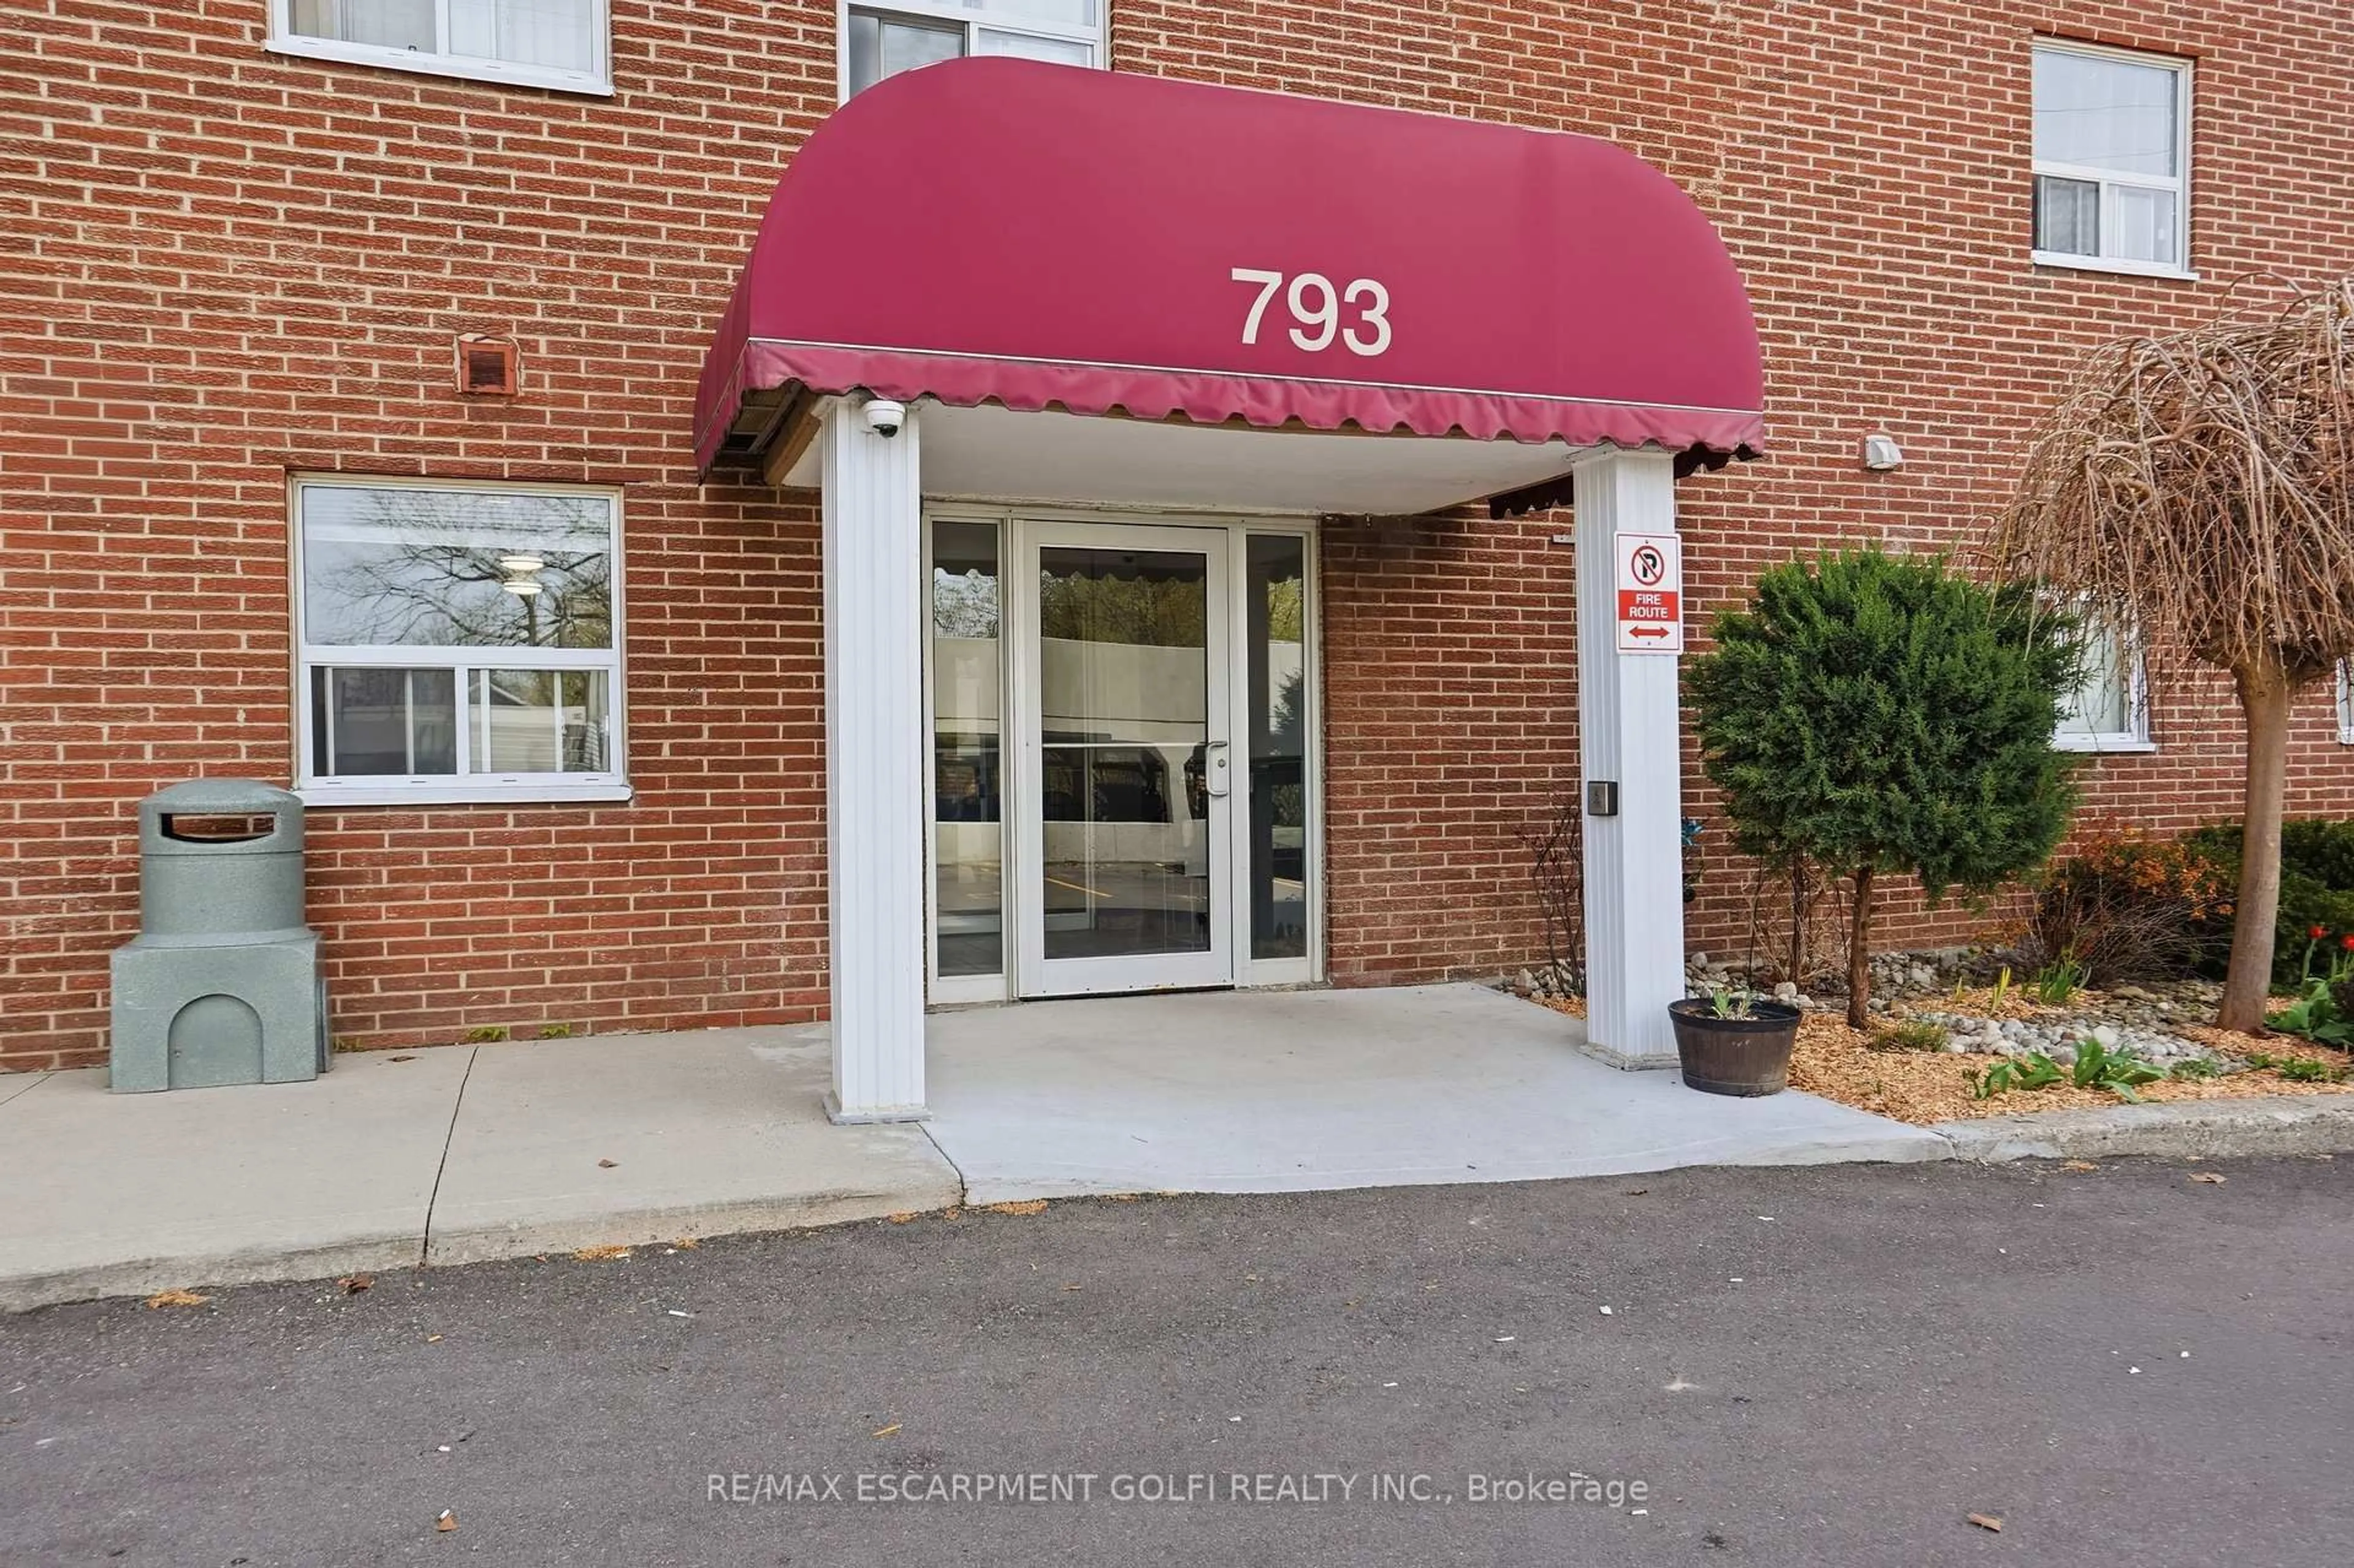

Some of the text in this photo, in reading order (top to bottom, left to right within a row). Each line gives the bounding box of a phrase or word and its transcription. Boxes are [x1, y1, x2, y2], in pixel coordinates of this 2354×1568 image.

[1231, 267, 1392, 356] 793
[1636, 593, 1662, 605] FIRE
[1629, 606, 1669, 618] ROUTE
